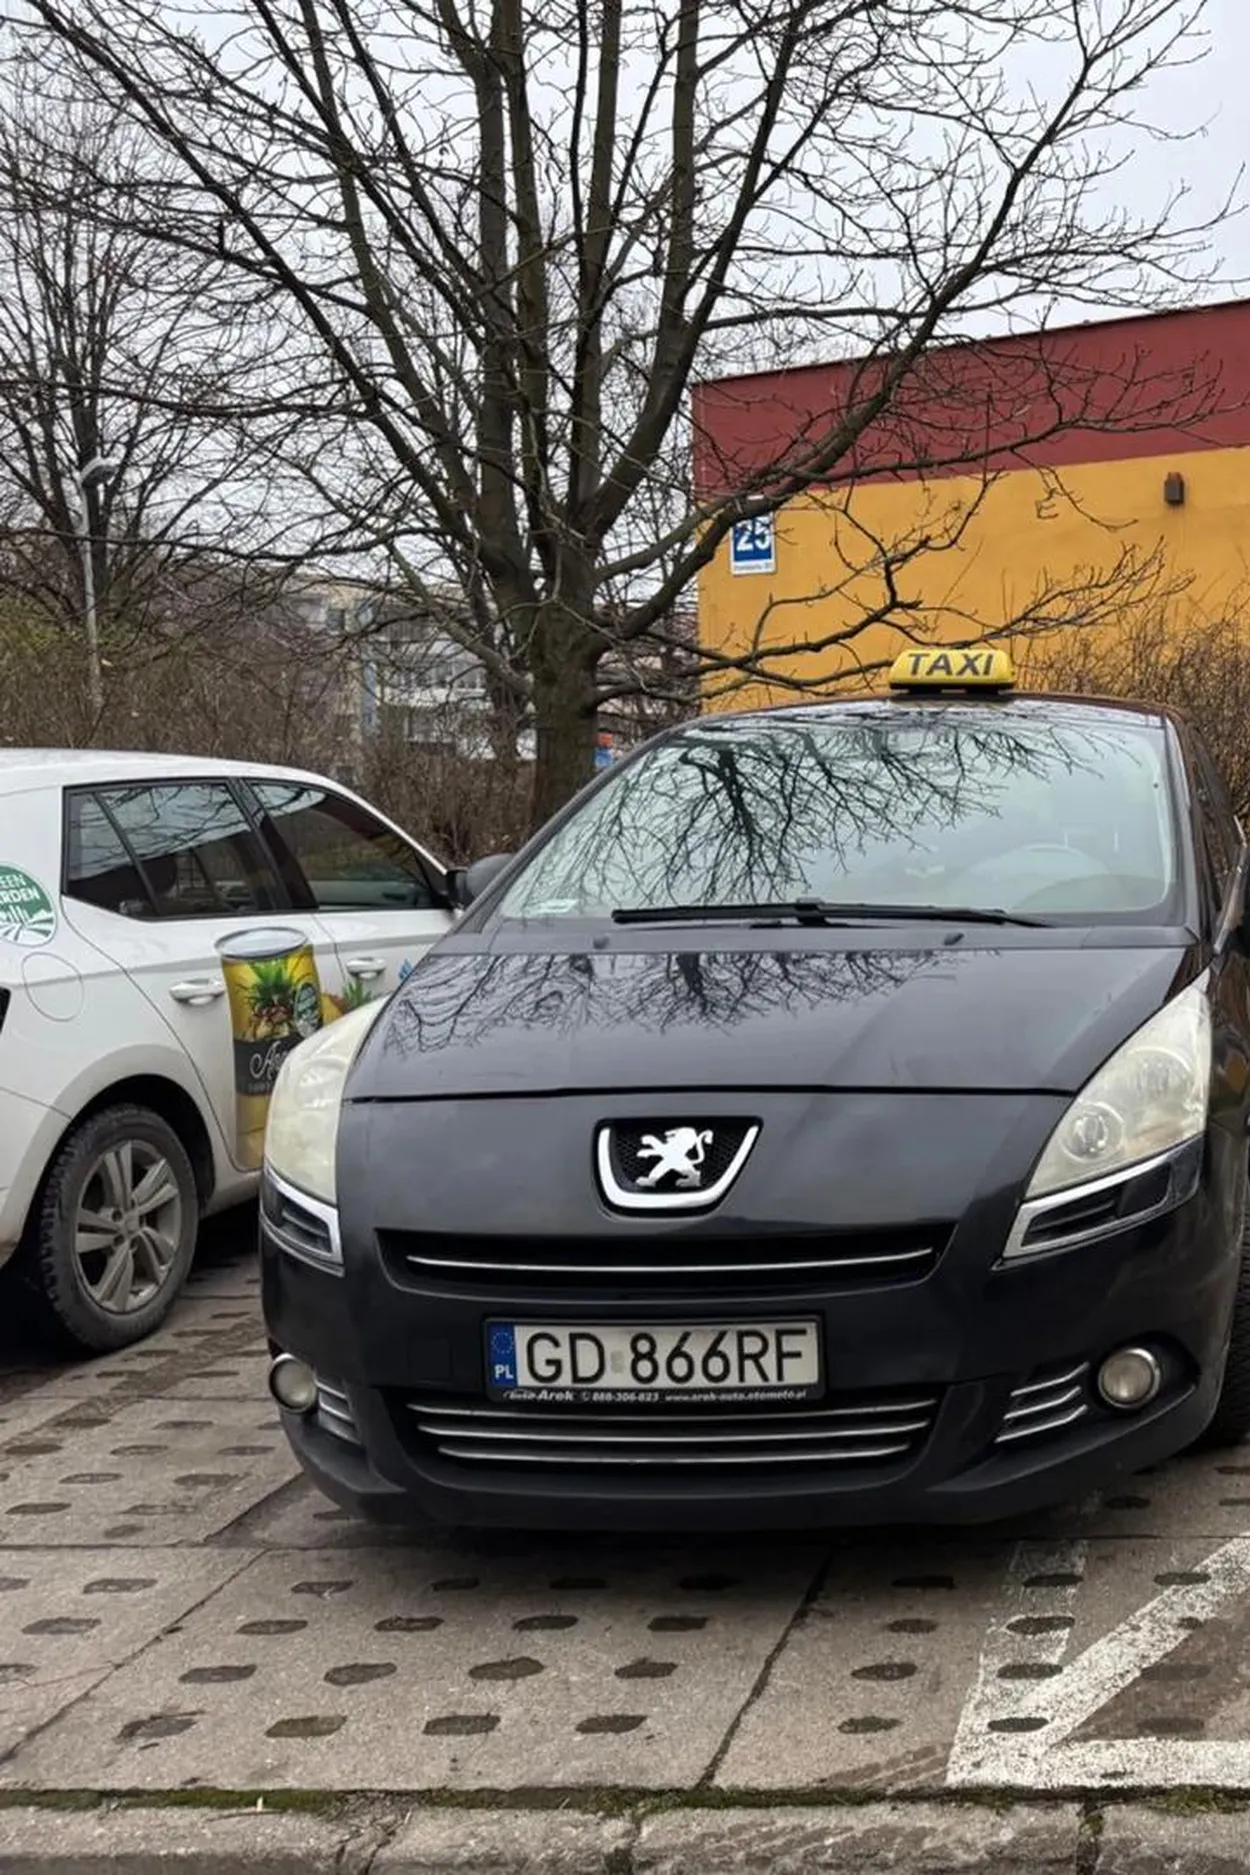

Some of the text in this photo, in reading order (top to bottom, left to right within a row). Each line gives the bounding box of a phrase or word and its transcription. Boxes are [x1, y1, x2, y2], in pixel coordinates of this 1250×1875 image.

[908, 653, 994, 676] TAXI
[526, 1328, 808, 1385] GD 866RF
[494, 1365, 514, 1379] PL
